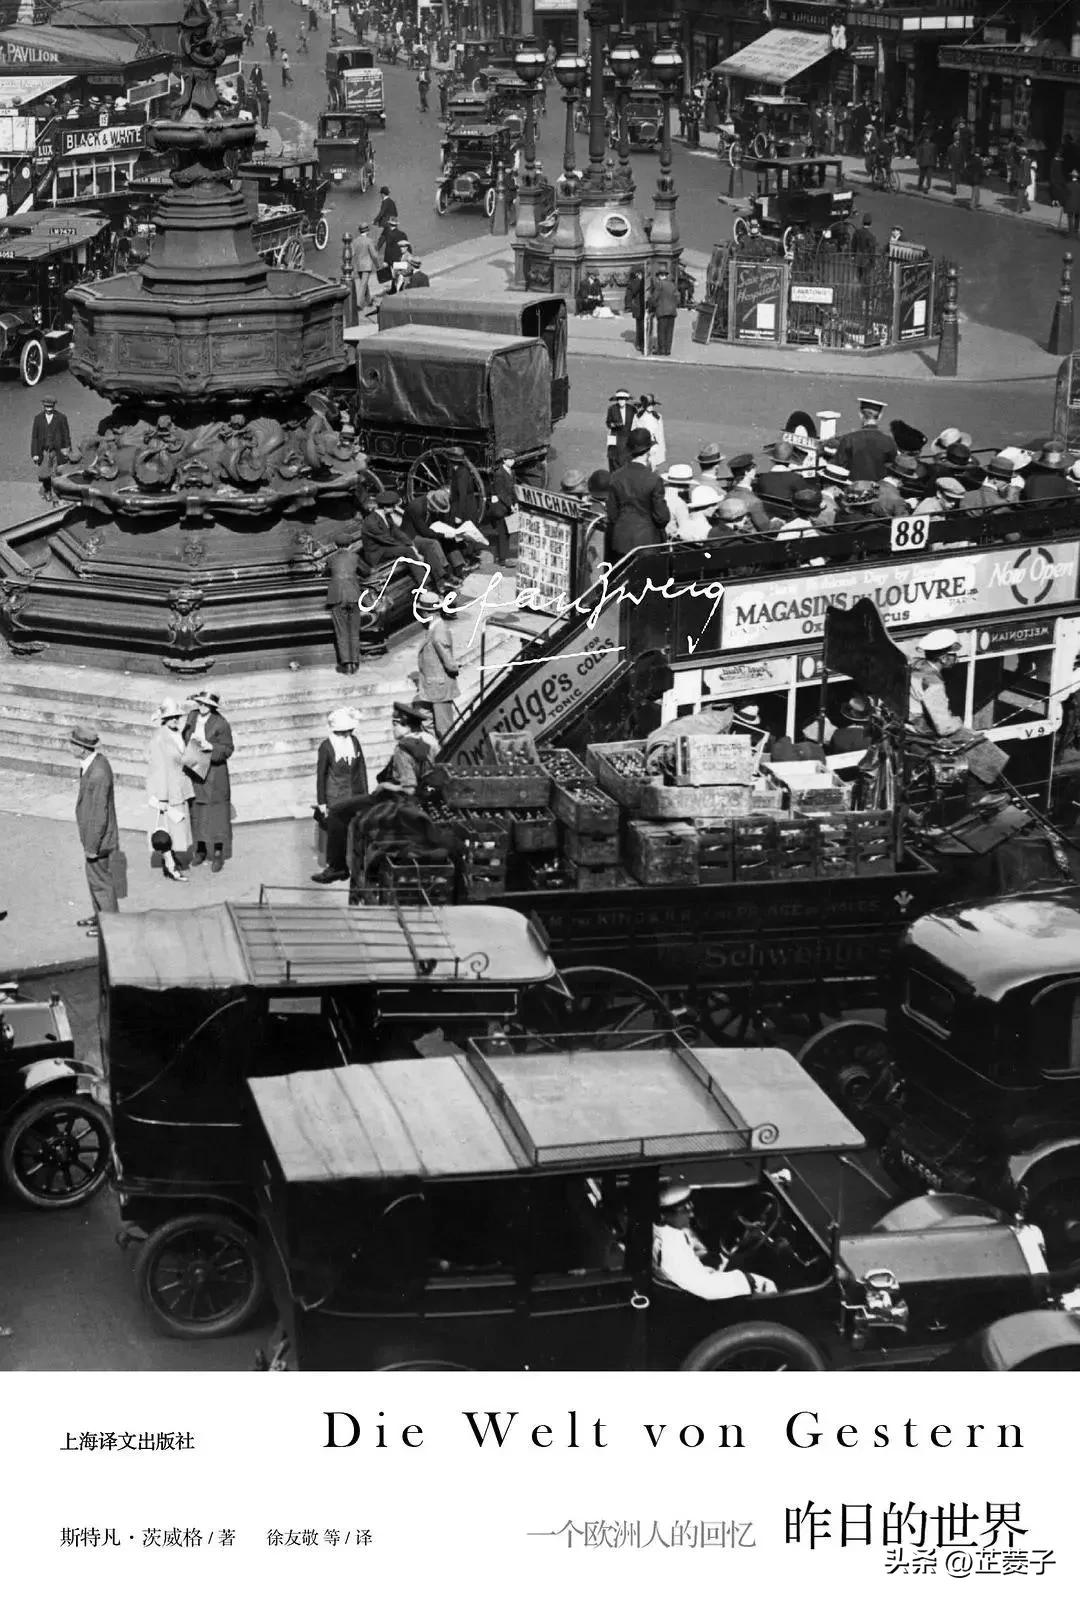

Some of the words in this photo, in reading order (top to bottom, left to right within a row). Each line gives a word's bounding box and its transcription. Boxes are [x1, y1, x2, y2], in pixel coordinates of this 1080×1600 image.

[8, 43, 59, 62] PAVILION
[38, 145, 53, 157] LUX
[66, 132, 101, 149] BLACK
[110, 129, 142, 145] WHITE
[522, 487, 578, 519] MITCHAM
[895, 520, 925, 547] 88
[989, 562, 1026, 588] Now
[1029, 555, 1075, 584] Open
[735, 592, 848, 627] MAGASINS
[875, 577, 966, 608] LOUVRE
[548, 688, 582, 718] TONIC
